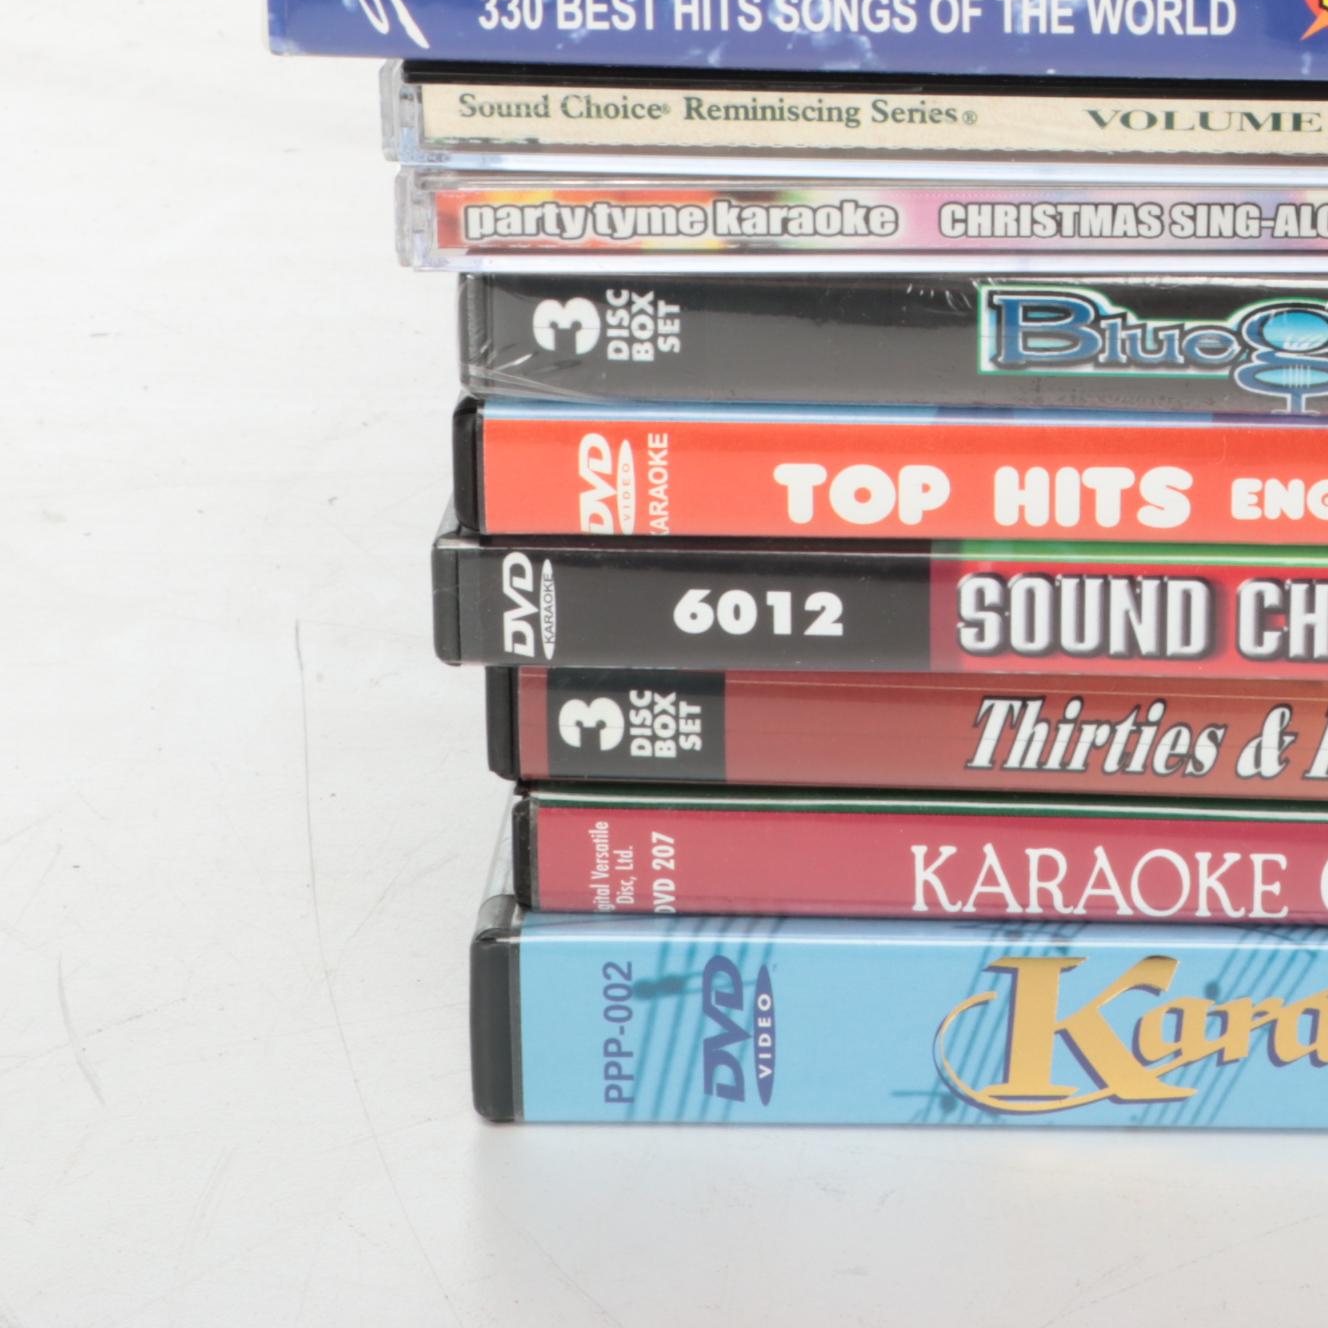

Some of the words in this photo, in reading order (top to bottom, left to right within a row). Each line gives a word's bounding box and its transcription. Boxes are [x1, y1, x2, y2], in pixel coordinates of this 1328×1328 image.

[458, 93, 550, 120] Sound
[683, 97, 861, 129] Reminiscing
[1086, 108, 1323, 134] VOLUME
[713, 198, 900, 238] karaoke
[938, 201, 1170, 239] CHRISTMAS
[532, 296, 602, 355] 3
[606, 288, 631, 362] DISC
[631, 289, 656, 363] BOX
[657, 299, 682, 354] SET
[578, 432, 618, 535] DVD
[622, 462, 631, 521] VIDEO
[647, 432, 670, 535] ARAOKE
[772, 462, 952, 526] TOP
[993, 465, 1195, 528] HITS
[502, 551, 536, 658] DVD
[542, 572, 555, 647] KARAOKE
[672, 588, 845, 638] 6012
[956, 573, 1214, 661] SOUND
[558, 696, 627, 752] 3
[630, 688, 654, 758] DISC
[653, 690, 678, 759] BOX
[678, 701, 703, 752] SET
[965, 694, 1227, 778] Thirties
[1233, 702, 1295, 784] &
[587, 820, 610, 880] Versatile
[612, 845, 634, 871] Ltd.
[651, 831, 675, 871] 207
[587, 883, 616, 912] gital
[615, 876, 638, 905] Disc,
[652, 877, 677, 914] DVD
[909, 842, 1289, 919] KARAOKE
[603, 959, 634, 1105] PPP-002
[702, 954, 753, 1102] DVD
[756, 992, 772, 1079] VIDEO
